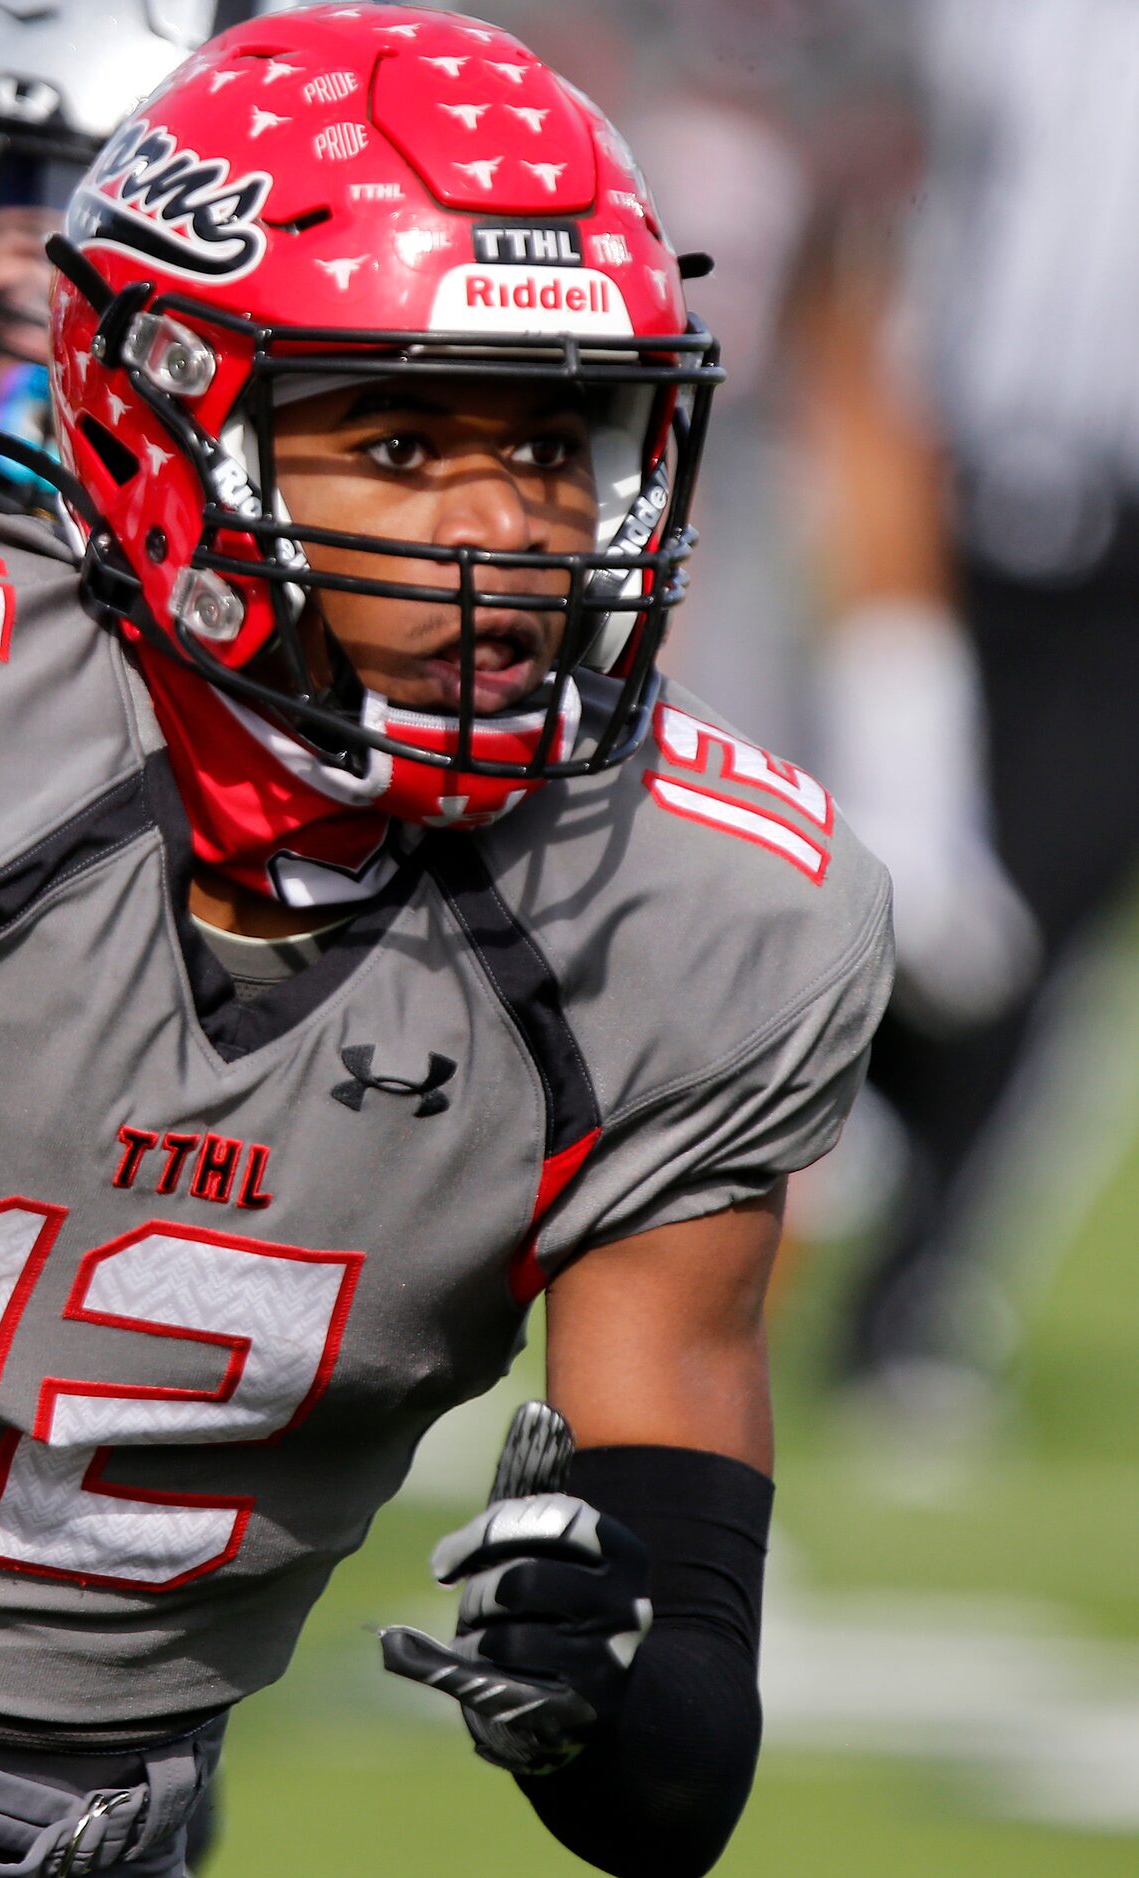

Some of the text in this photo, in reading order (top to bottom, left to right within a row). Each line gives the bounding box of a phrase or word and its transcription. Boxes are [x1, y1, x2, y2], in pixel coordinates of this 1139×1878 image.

[303, 72, 358, 103] PRIDE
[314, 121, 369, 160] PRIDE
[349, 183, 405, 198] TTHL
[477, 229, 581, 262] TTHL
[465, 274, 610, 313] Riddell
[642, 703, 833, 886] 12
[112, 1124, 274, 1210] TTHL
